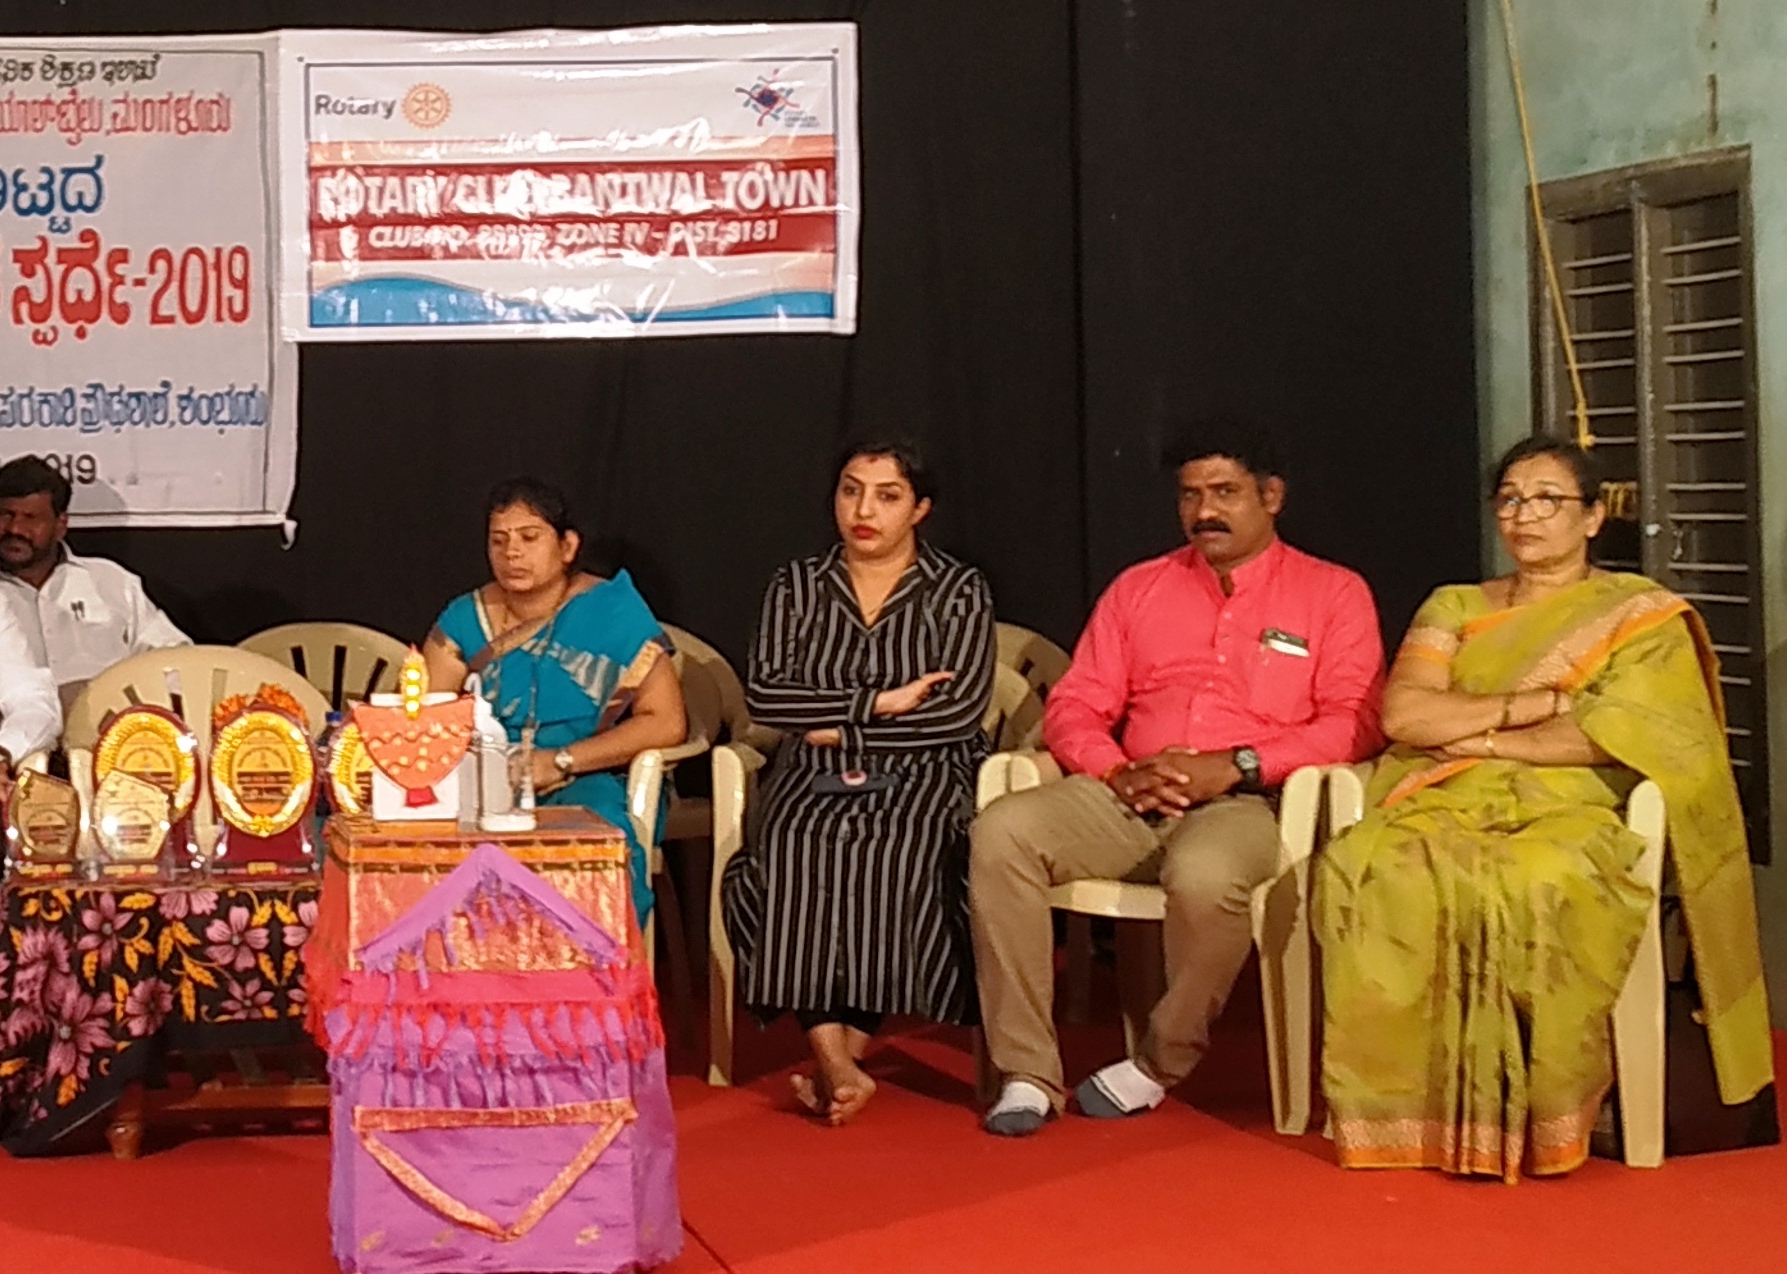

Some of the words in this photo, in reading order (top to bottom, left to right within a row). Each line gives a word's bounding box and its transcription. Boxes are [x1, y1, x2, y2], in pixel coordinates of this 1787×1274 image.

[314, 94, 397, 120] Rotary
[720, 165, 826, 211] TOWN
[556, 222, 621, 245] ZONE
[11, 228, 251, 347] ಸ್ಪರ್ಧೆ-2019
